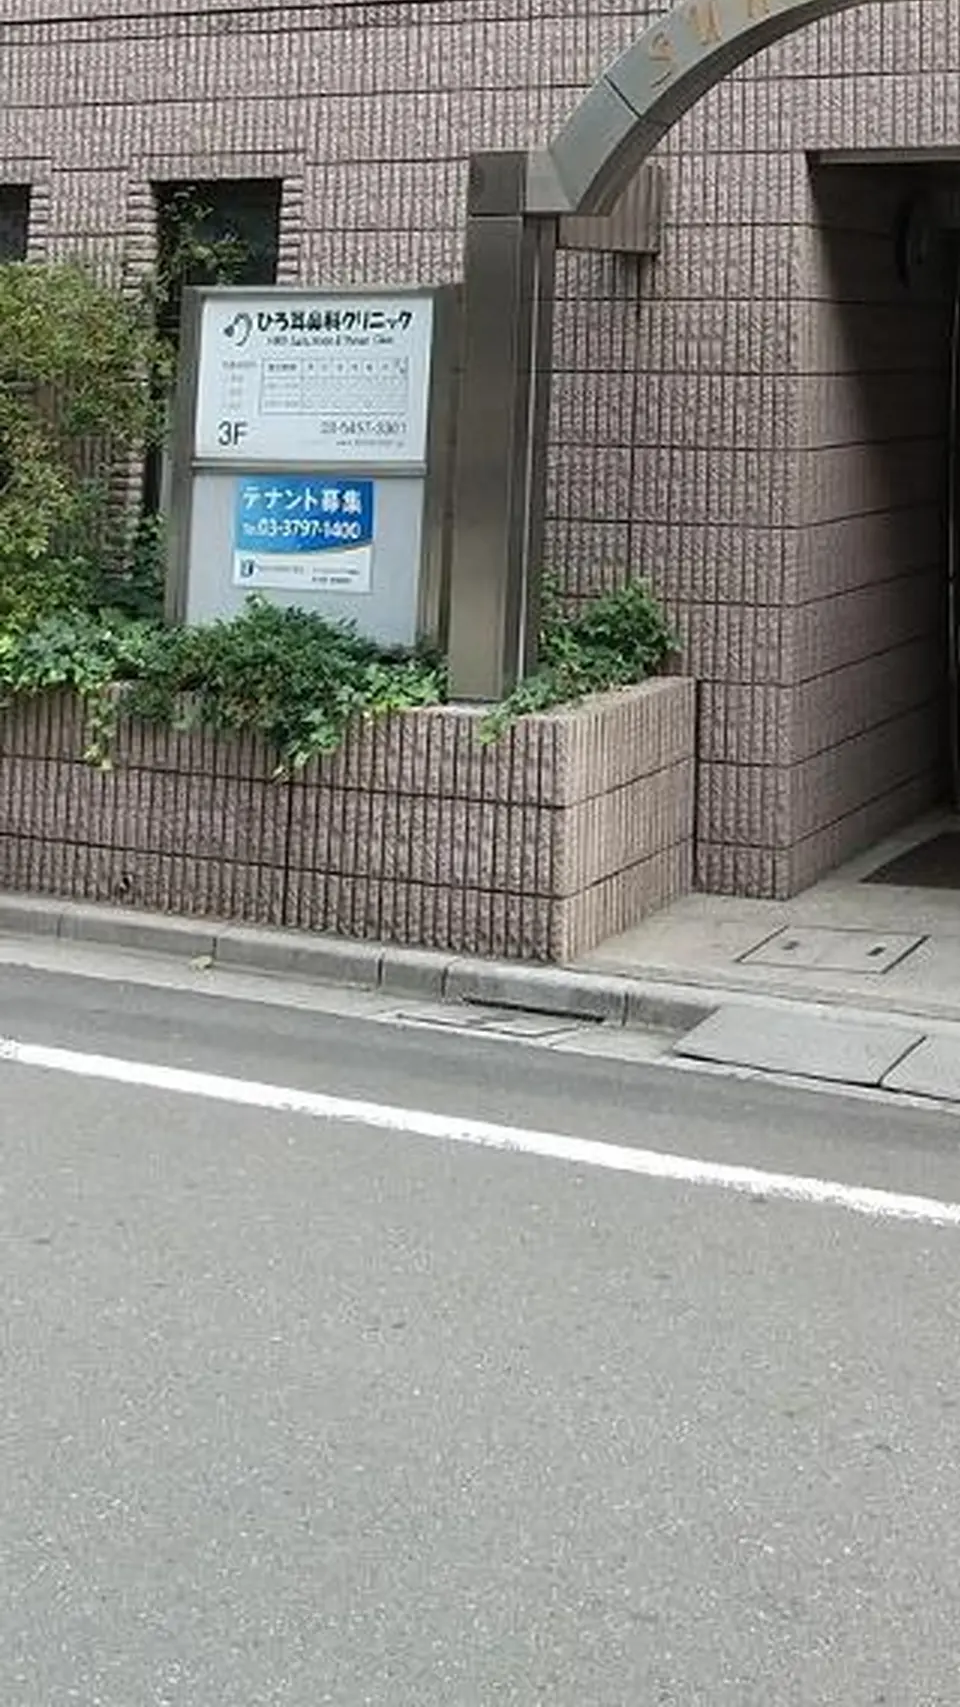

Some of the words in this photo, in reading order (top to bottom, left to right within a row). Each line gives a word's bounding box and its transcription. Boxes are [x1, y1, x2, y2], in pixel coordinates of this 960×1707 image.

[218, 420, 248, 445] 3F
[242, 486, 362, 515] テナント募集
